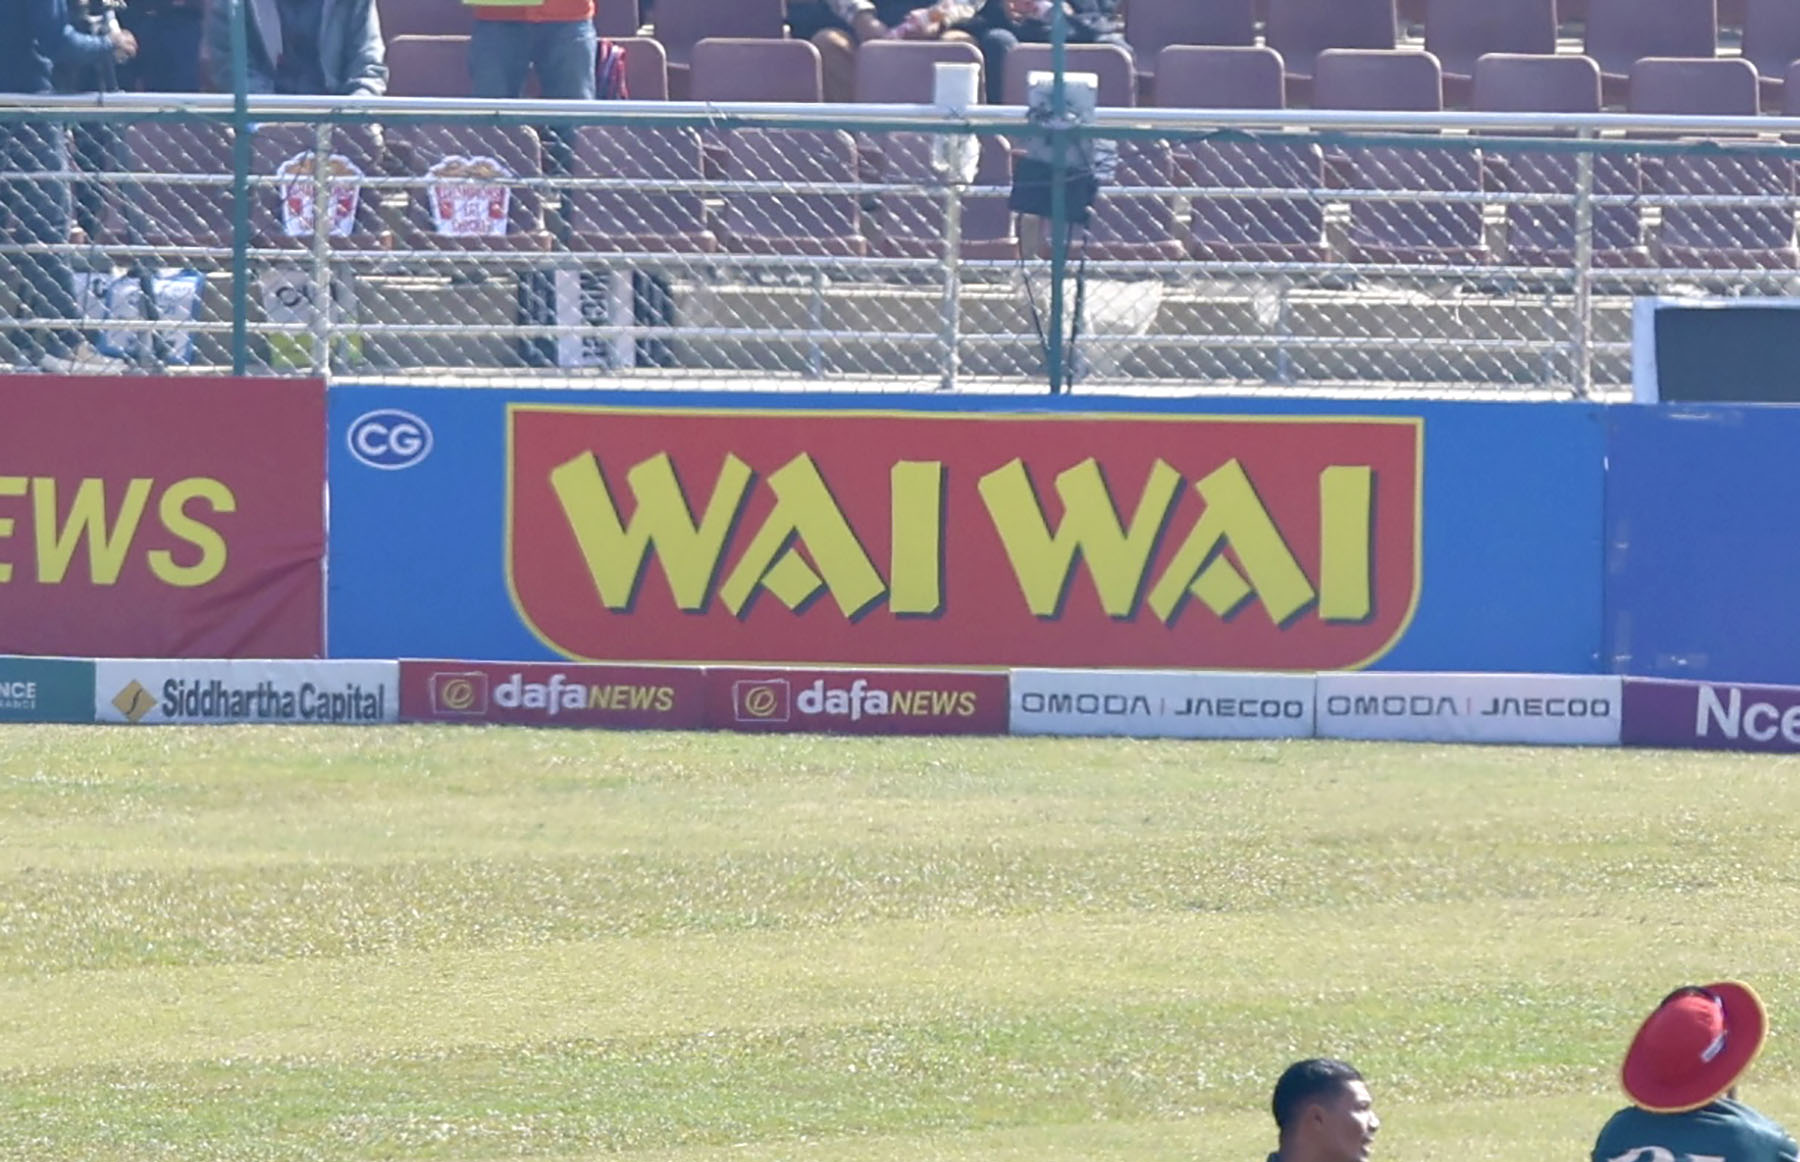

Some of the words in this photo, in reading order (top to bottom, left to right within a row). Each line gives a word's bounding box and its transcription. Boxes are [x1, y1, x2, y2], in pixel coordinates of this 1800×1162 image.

[357, 423, 422, 456] CG
[551, 450, 946, 622] WAI
[978, 457, 1376, 629] WAI
[162, 679, 297, 718] Siddhartha
[300, 683, 385, 721] Capital
[494, 673, 675, 715] dafaNEWS
[797, 678, 977, 720] dafaNEWS
[1021, 692, 1151, 716] OMODA
[1174, 697, 1303, 719] JAECOO
[1327, 695, 1458, 718] OMODA
[1481, 698, 1610, 718] JAECOO
